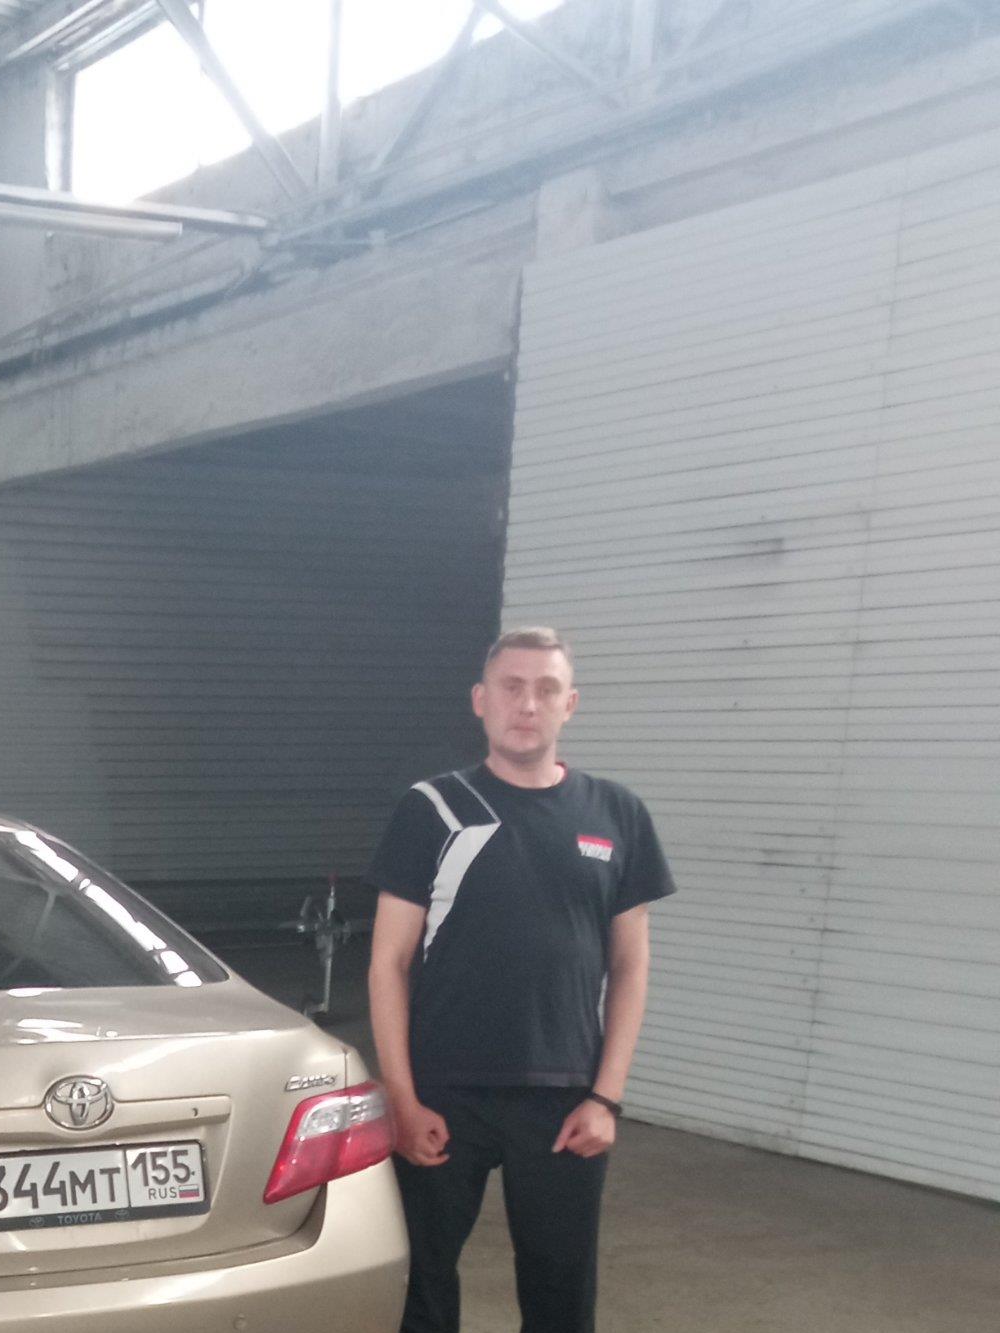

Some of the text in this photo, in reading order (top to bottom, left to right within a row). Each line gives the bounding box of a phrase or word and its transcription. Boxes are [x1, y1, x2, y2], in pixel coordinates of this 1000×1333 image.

[131, 1149, 191, 1187] 155
[148, 1187, 178, 1200] RUS
[56, 1212, 103, 1226] TOYOTA
